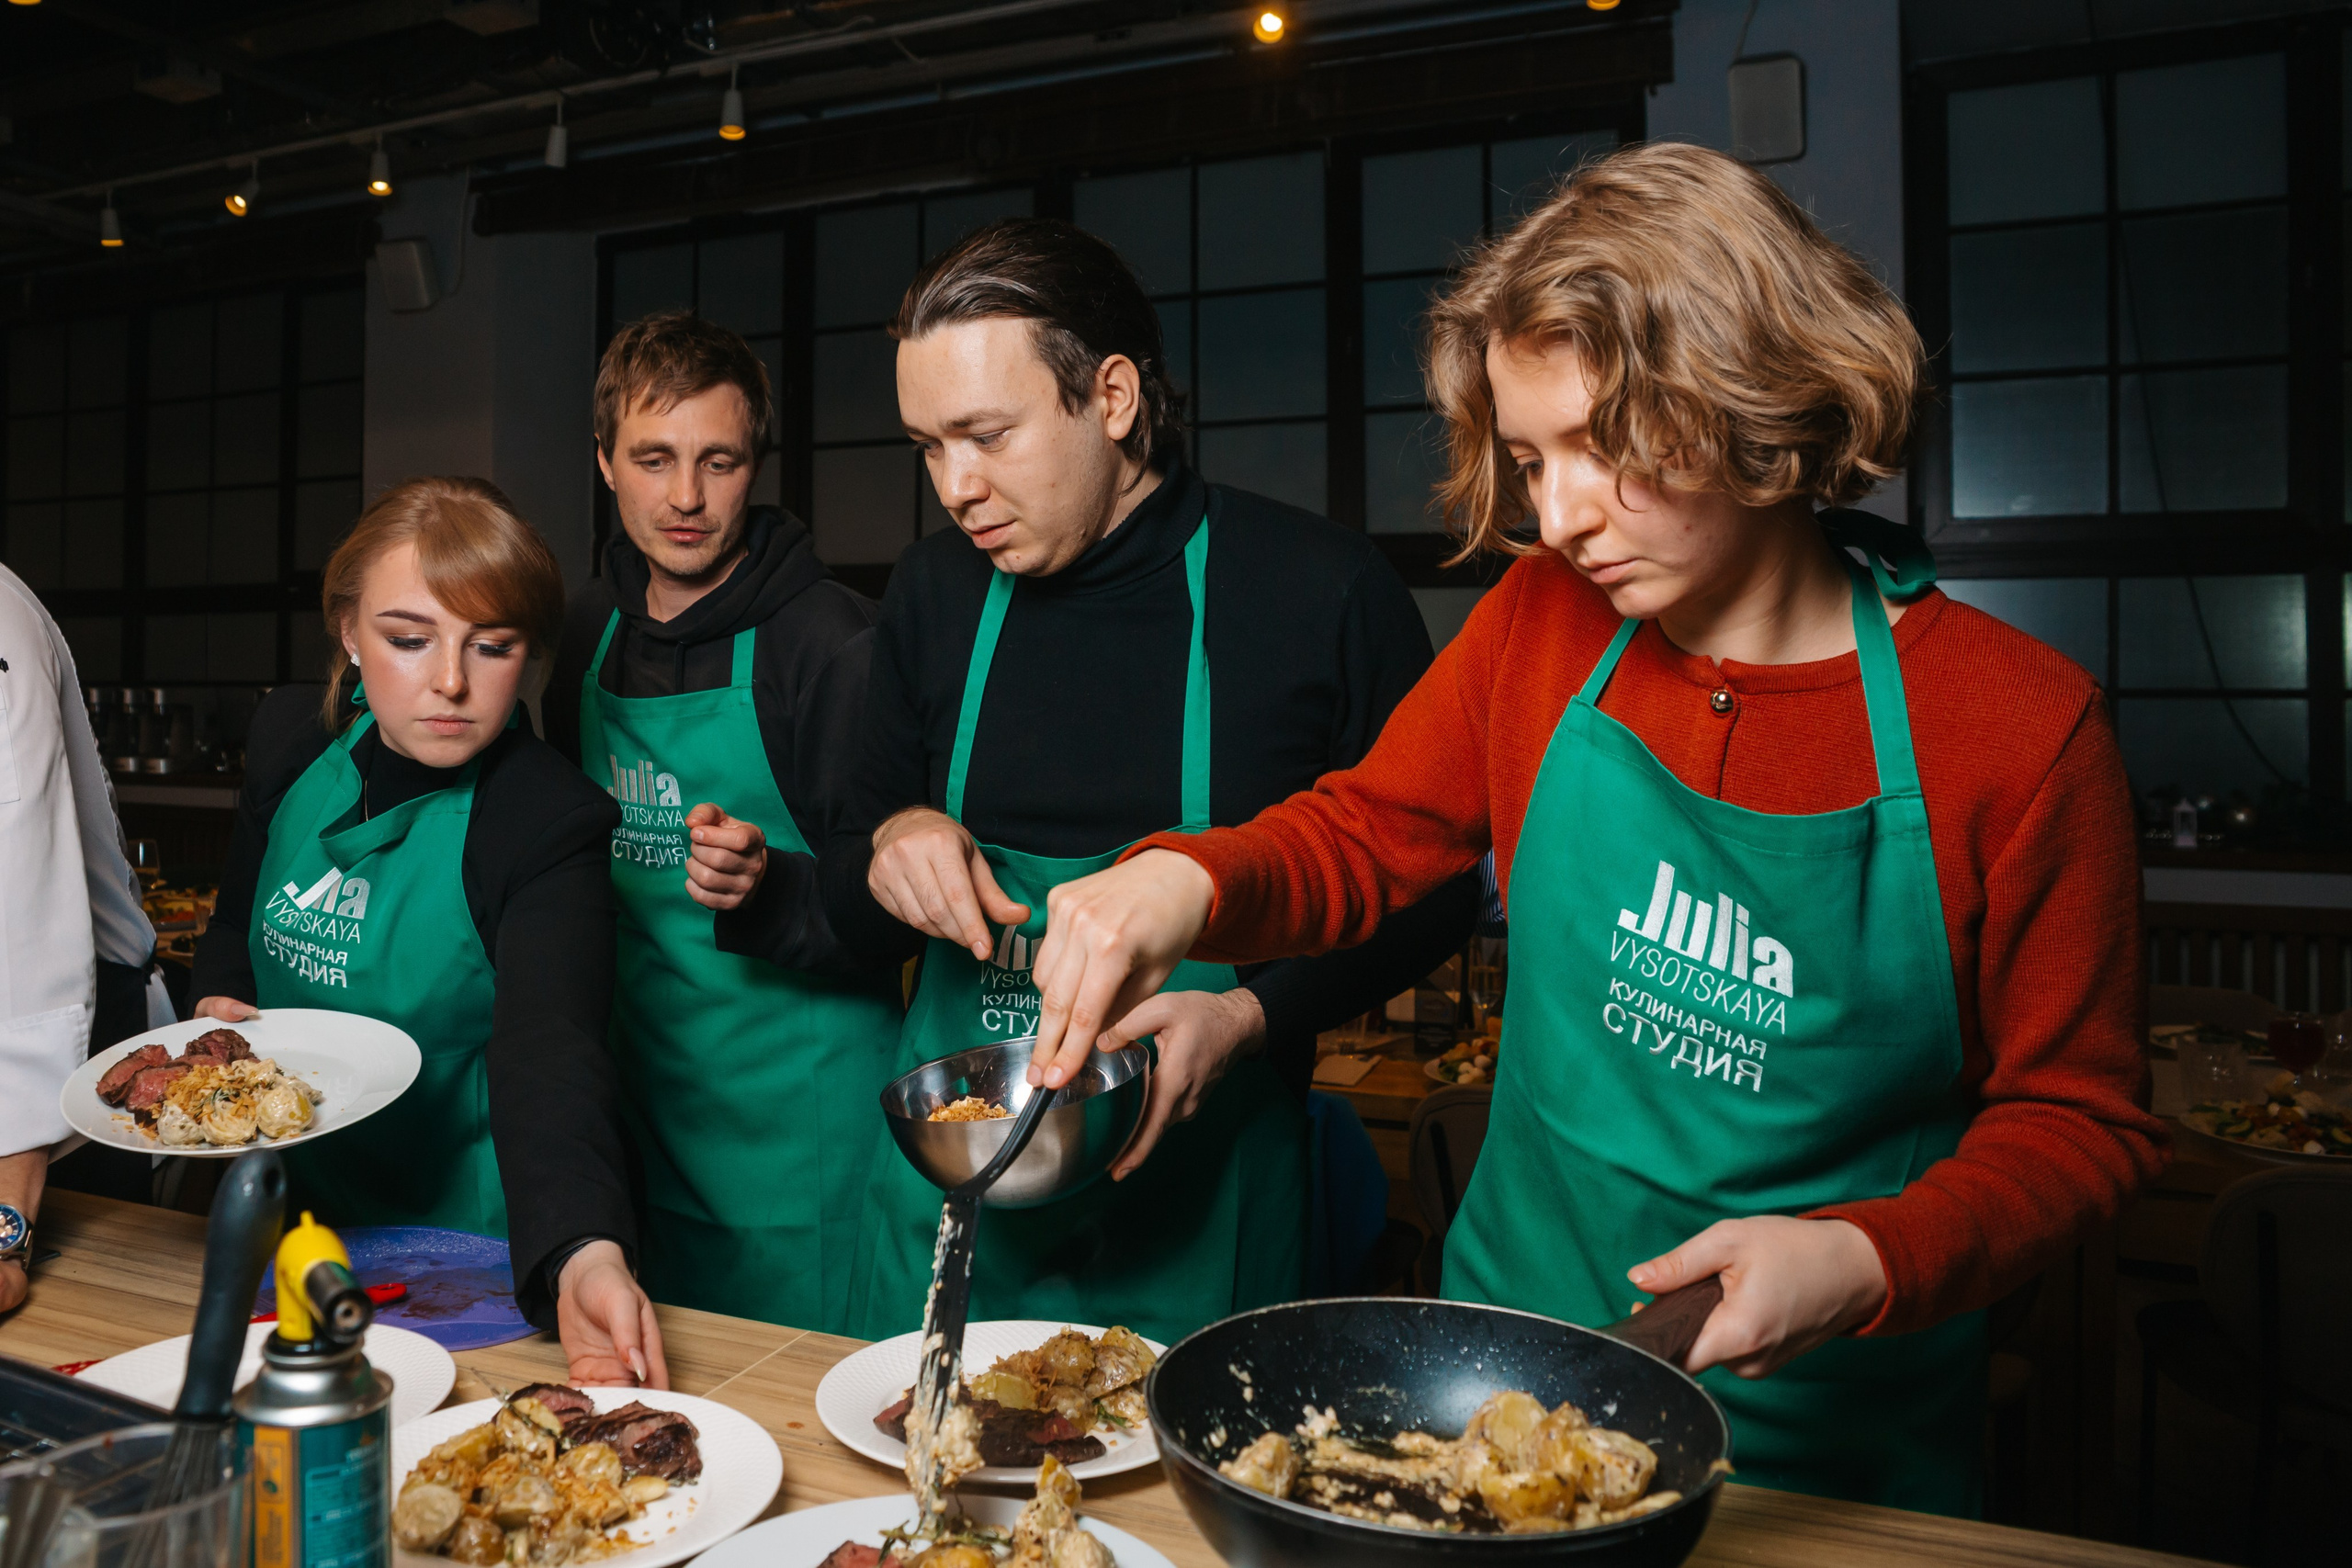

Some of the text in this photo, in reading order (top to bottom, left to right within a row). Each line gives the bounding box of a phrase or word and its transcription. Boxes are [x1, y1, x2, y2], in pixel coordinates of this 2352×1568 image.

[607, 754, 682, 807] Julia
[622, 805, 685, 828] OTSKAYA
[612, 839, 687, 868] СТУДИЯ
[263, 919, 348, 966] КУЛИНАРНАЯ
[265, 891, 360, 944] VYSSKAYA
[1617, 860, 1793, 998] Julia
[264, 935, 347, 988] СТУДИЯ
[1611, 931, 1785, 1034] VYSOTSKAYA
[981, 1009, 1039, 1037] СТУ
[982, 993, 1042, 1010] КУЛИН
[1609, 977, 1767, 1060] КУЛИНАРНАЯ
[1602, 1003, 1763, 1092] СТУДИЯ
